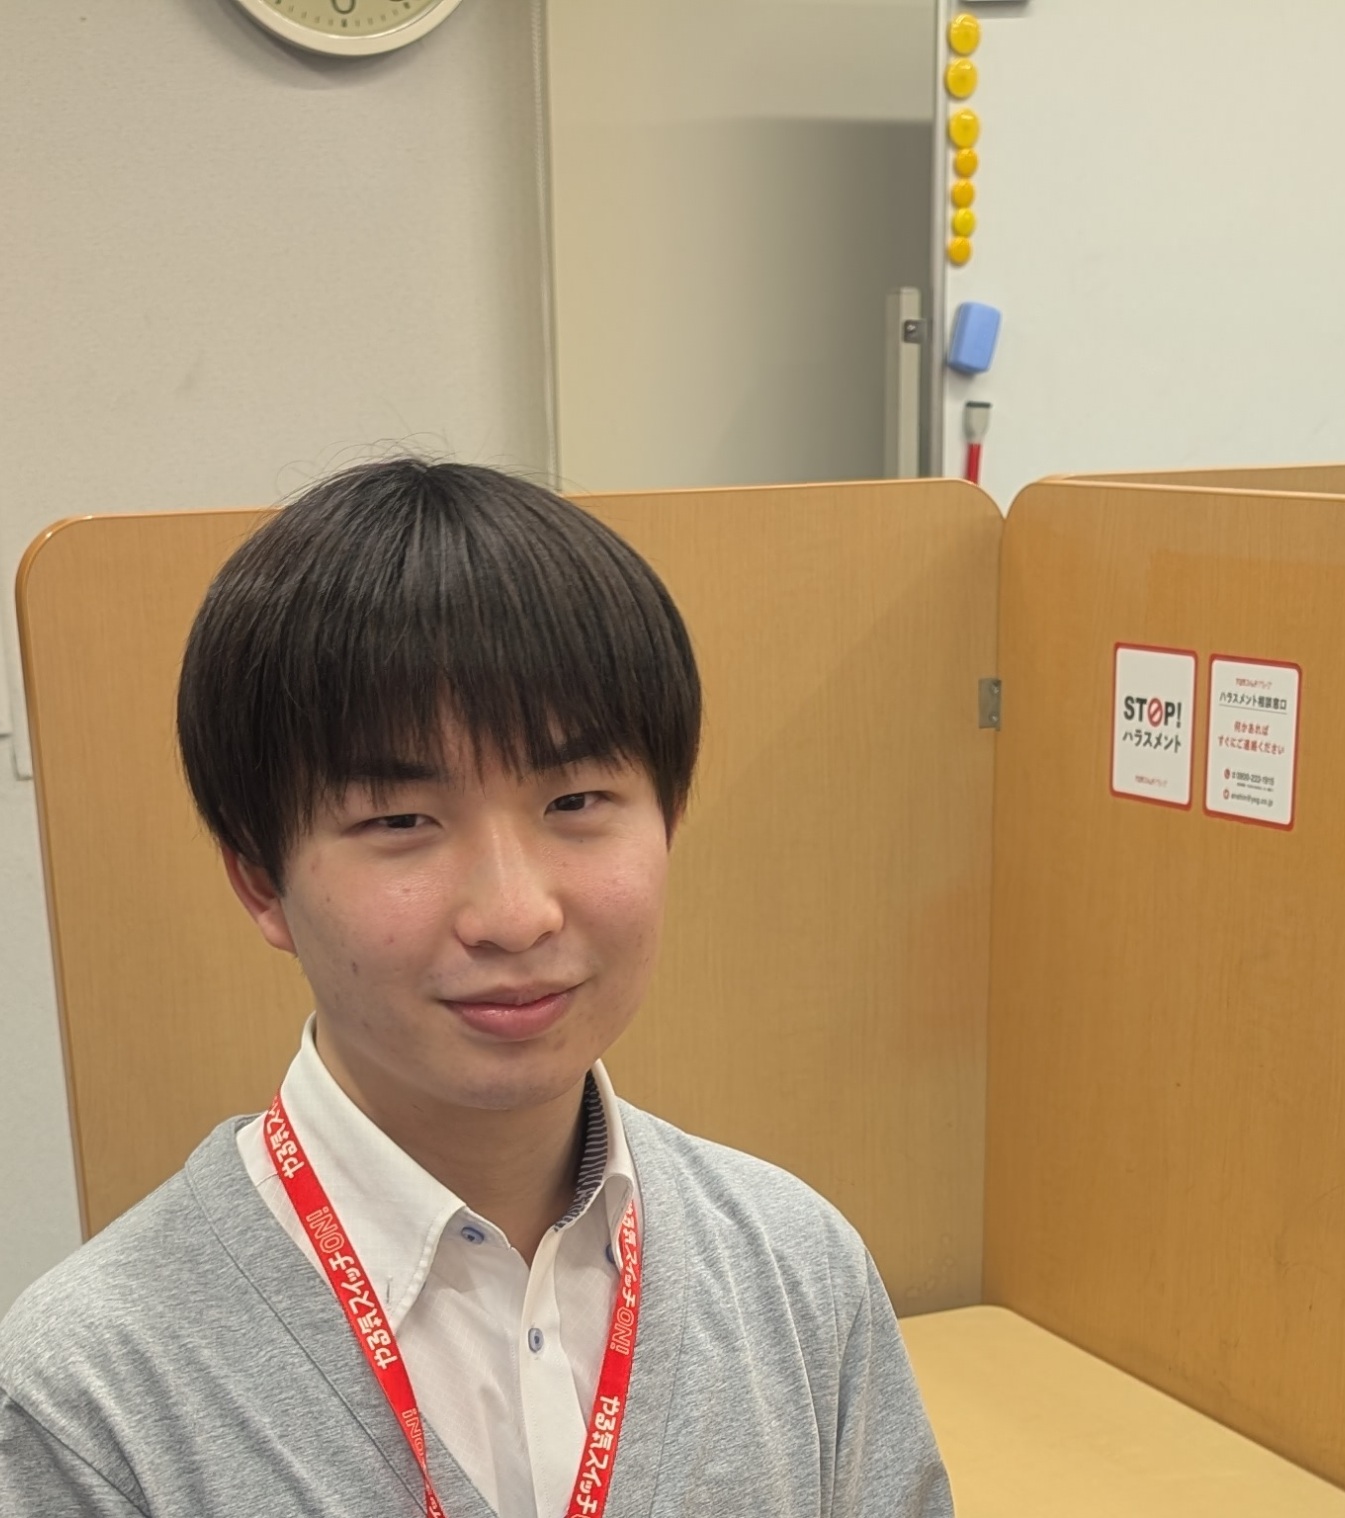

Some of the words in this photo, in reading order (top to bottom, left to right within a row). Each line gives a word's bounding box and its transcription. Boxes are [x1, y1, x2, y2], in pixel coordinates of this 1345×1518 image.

[1123, 695, 1182, 729] STOP!
[1122, 729, 1182, 754] ハラスメント
